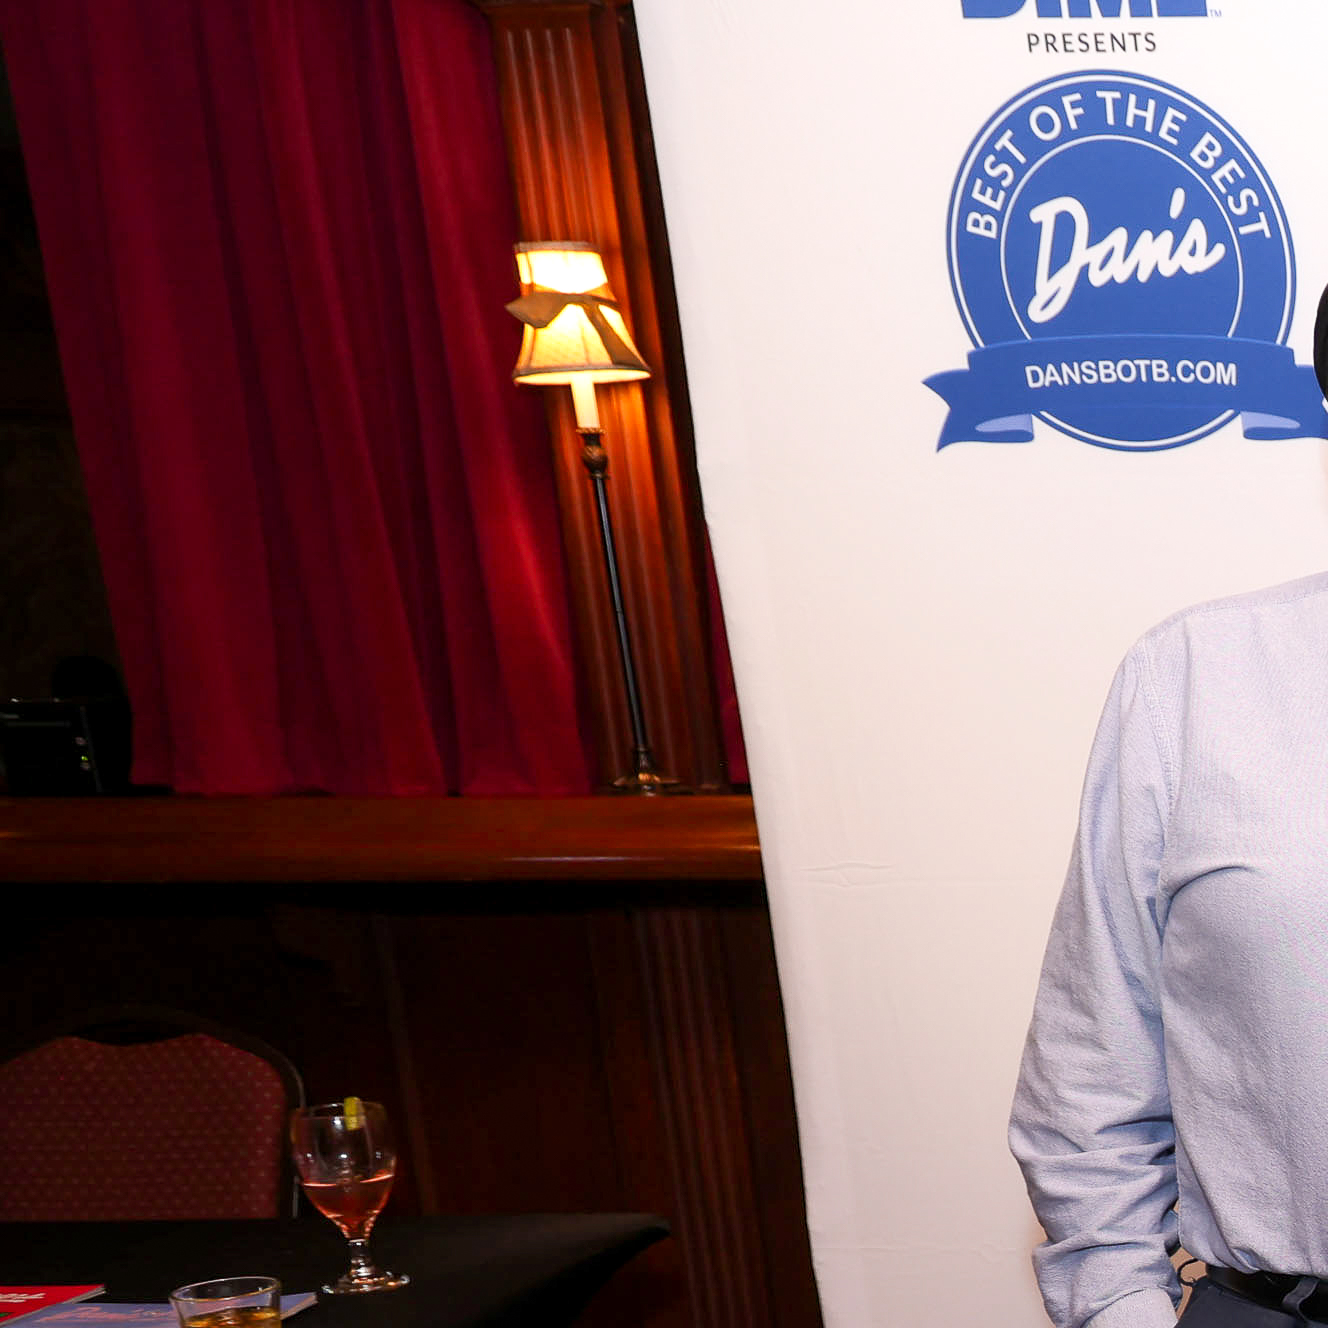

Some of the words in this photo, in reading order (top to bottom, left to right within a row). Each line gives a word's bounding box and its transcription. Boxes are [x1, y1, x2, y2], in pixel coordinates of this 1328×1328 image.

[1026, 32, 1157, 53] PRESENTS
[966, 131, 1027, 239] BEST
[1028, 92, 1085, 141] OF
[1095, 90, 1187, 145] THE
[1190, 131, 1271, 239] BEST
[1028, 187, 1225, 323] Dan's
[1025, 359, 1237, 388] DANSBOTB.COM
